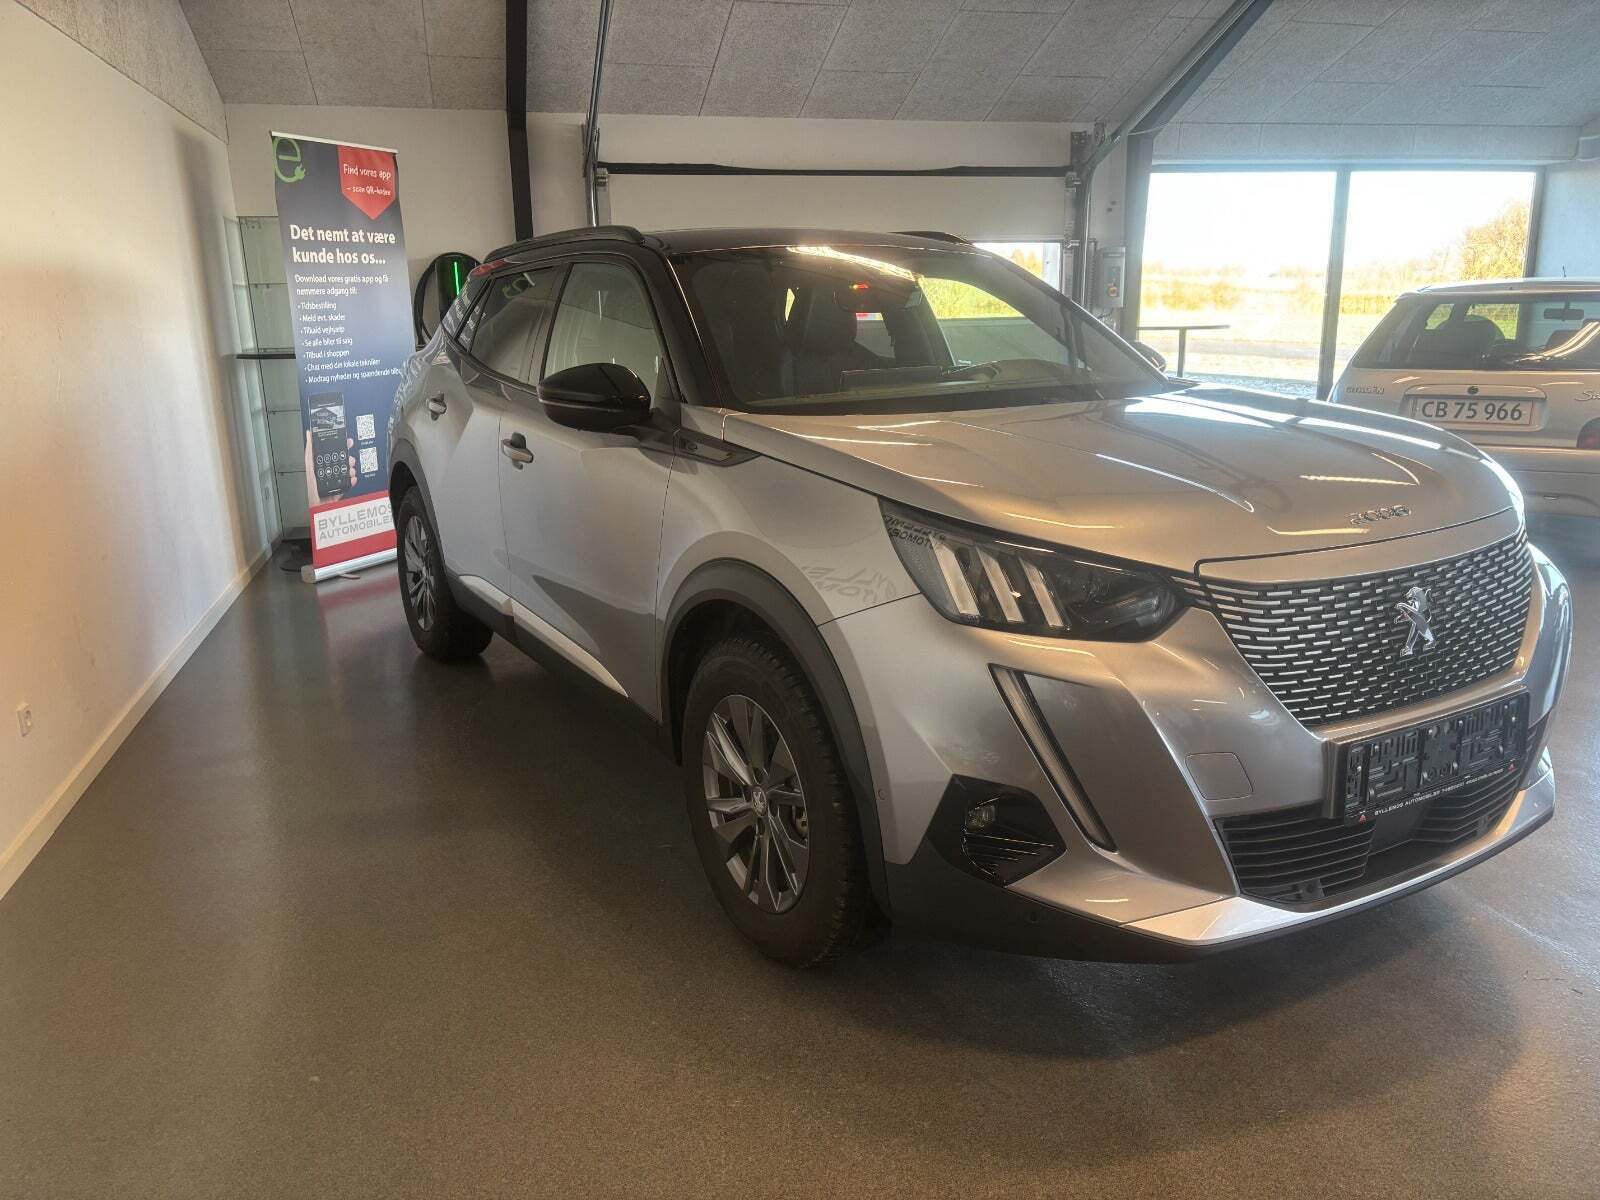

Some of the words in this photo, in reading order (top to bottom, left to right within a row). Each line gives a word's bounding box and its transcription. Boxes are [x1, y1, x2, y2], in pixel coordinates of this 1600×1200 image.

[343, 163, 358, 176] Find
[359, 168, 378, 178] vores
[379, 170, 391, 181] app
[290, 224, 315, 240] Det
[317, 229, 349, 243] nemt
[351, 230, 365, 243] at
[366, 232, 396, 244] være
[292, 246, 334, 264] kunde
[335, 248, 359, 264] hos
[361, 253, 386, 265] os...
[294, 274, 327, 283] Download
[344, 275, 361, 285] gratis
[361, 276, 373, 285] app
[374, 276, 382, 285] og
[296, 288, 326, 296] nemmere
[326, 287, 349, 297] adgang
[1421, 401, 1448, 418] CB
[1453, 401, 1478, 419] 75
[1483, 402, 1522, 421] 966
[319, 515, 393, 540] AUTOMOBILE
